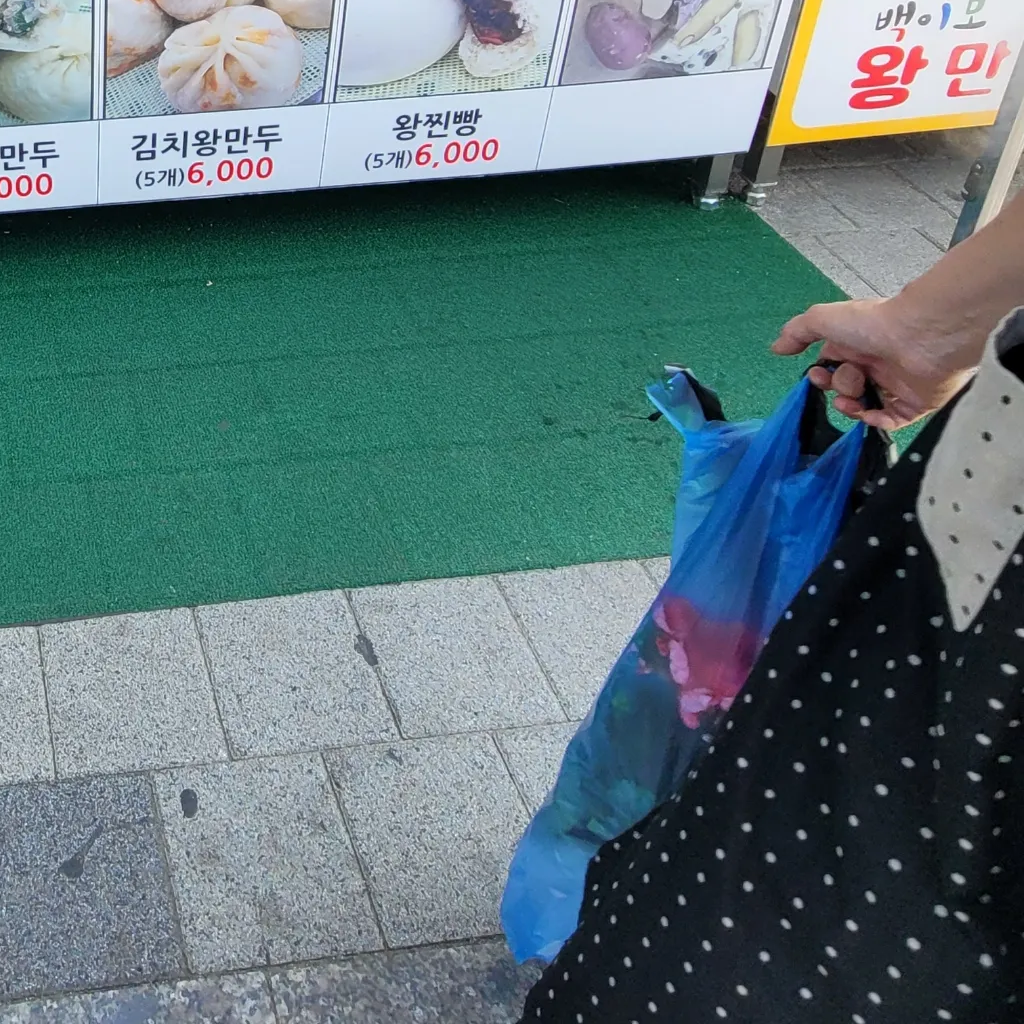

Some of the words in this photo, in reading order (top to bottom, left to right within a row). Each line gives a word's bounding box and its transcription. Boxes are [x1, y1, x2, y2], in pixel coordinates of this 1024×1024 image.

[392, 108, 482, 141] 왕찐빵
[130, 124, 284, 163] 김치왕만두
[414, 139, 500, 169] 6,000
[187, 156, 274, 187] 6,000
